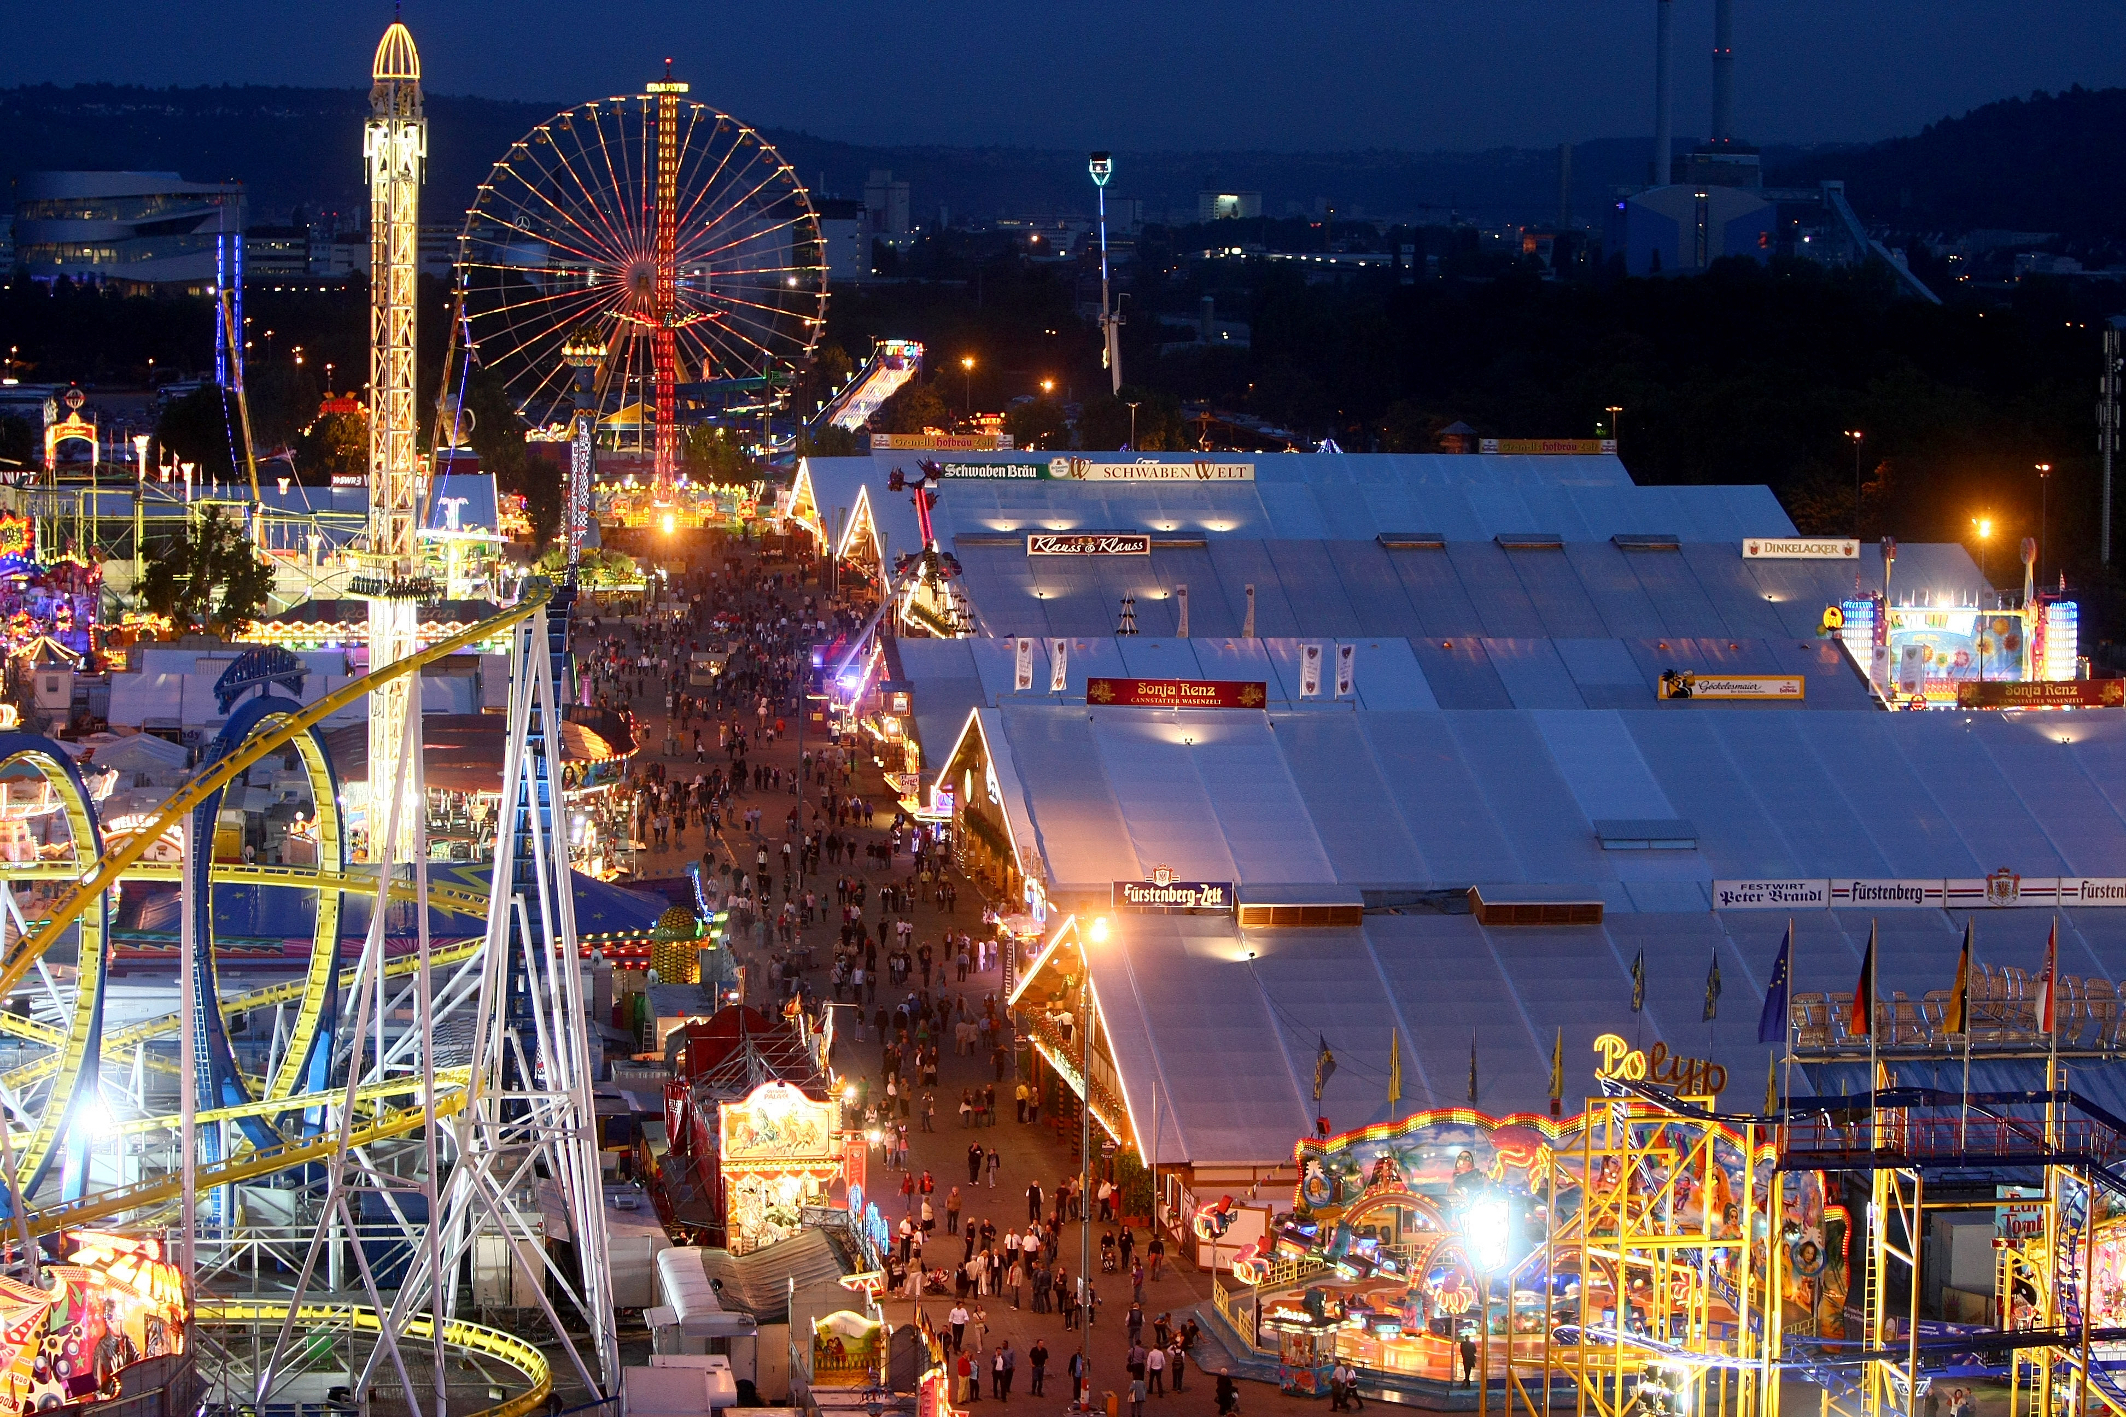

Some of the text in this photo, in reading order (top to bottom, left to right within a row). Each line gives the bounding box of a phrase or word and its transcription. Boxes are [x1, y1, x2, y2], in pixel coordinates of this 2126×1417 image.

[944, 463, 1006, 478] Schwaben
[1007, 464, 1037, 478] Bräu
[1103, 466, 1192, 479] SCHWABEN
[1034, 537, 1081, 553] Klauss
[1098, 537, 1143, 553] Klauss
[1764, 542, 1839, 555] DINKELACKER
[1137, 683, 1216, 697] Sonja Renz
[2005, 684, 2078, 698] Sonja Renz
[1740, 883, 1806, 891] FESTWIRT
[1852, 882, 1923, 904] Fürstenberg
[1124, 884, 1223, 906] Fürstenberg-Zelt
[1719, 890, 1822, 906] Peter Brandl
[1593, 1033, 1728, 1095] Polyp
